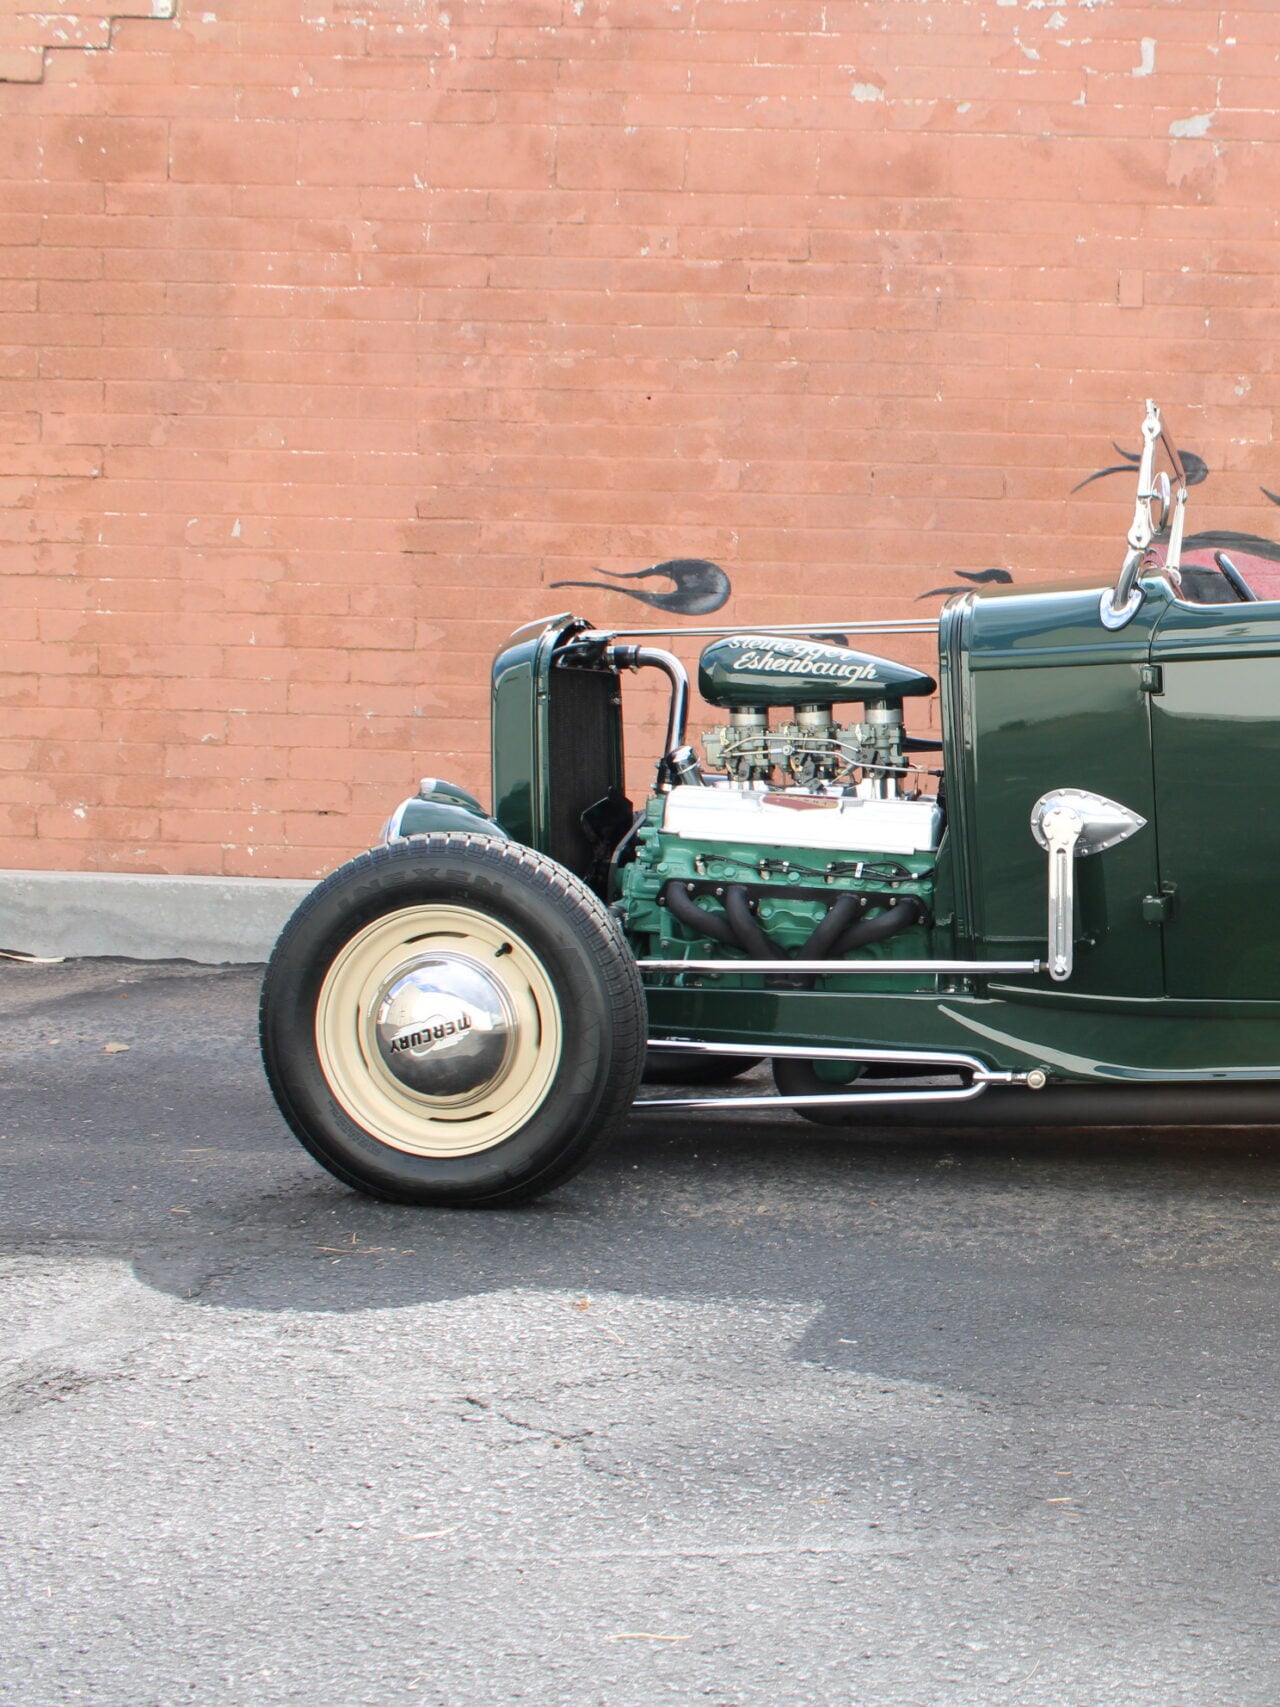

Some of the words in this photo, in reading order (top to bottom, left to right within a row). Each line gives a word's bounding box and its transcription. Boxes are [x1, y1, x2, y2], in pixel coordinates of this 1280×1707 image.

[733, 651, 878, 686] Eshenbaugh
[353, 867, 504, 897] NEXEN
[390, 1012, 471, 1053] MERCURY
